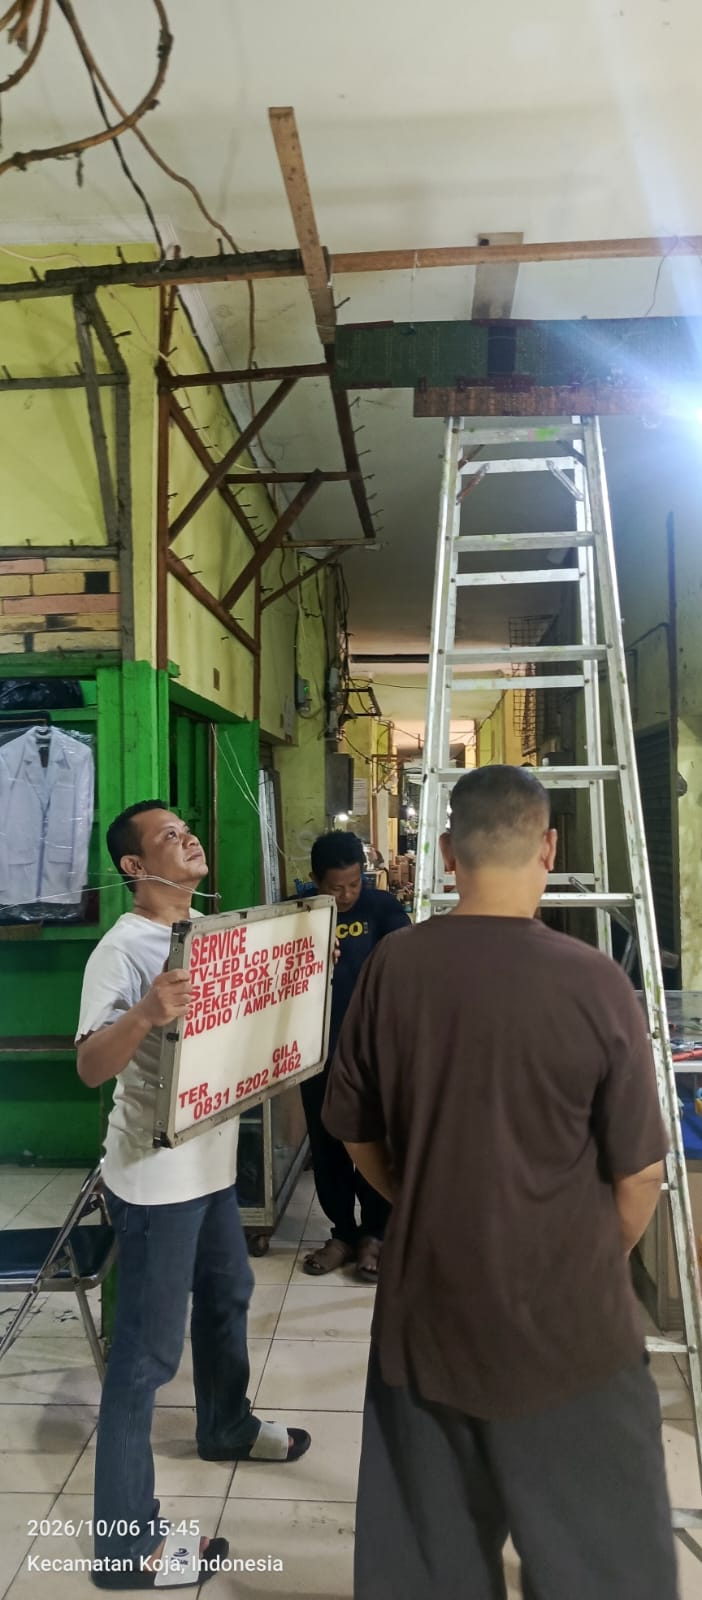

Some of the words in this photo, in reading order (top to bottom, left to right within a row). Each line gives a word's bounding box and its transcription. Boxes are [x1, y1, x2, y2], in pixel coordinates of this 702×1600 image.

[190, 927, 247, 968] SERVICE
[190, 957, 240, 984] TV-LED
[244, 949, 268, 969] LCD
[272, 936, 315, 960] DIGITAL
[190, 963, 270, 1001] SETBOX
[285, 950, 315, 971] STB
[184, 1008, 232, 1039] AUDIO
[244, 980, 309, 1016] AMPLYFIER
[185, 990, 237, 1021] SPEKER
[241, 978, 273, 1002] AKTIF
[272, 1040, 298, 1063] GILA
[179, 1082, 208, 1108] TER
[193, 1088, 230, 1120] 0831
[236, 1069, 268, 1099] 5202
[272, 1054, 301, 1078] 4462
